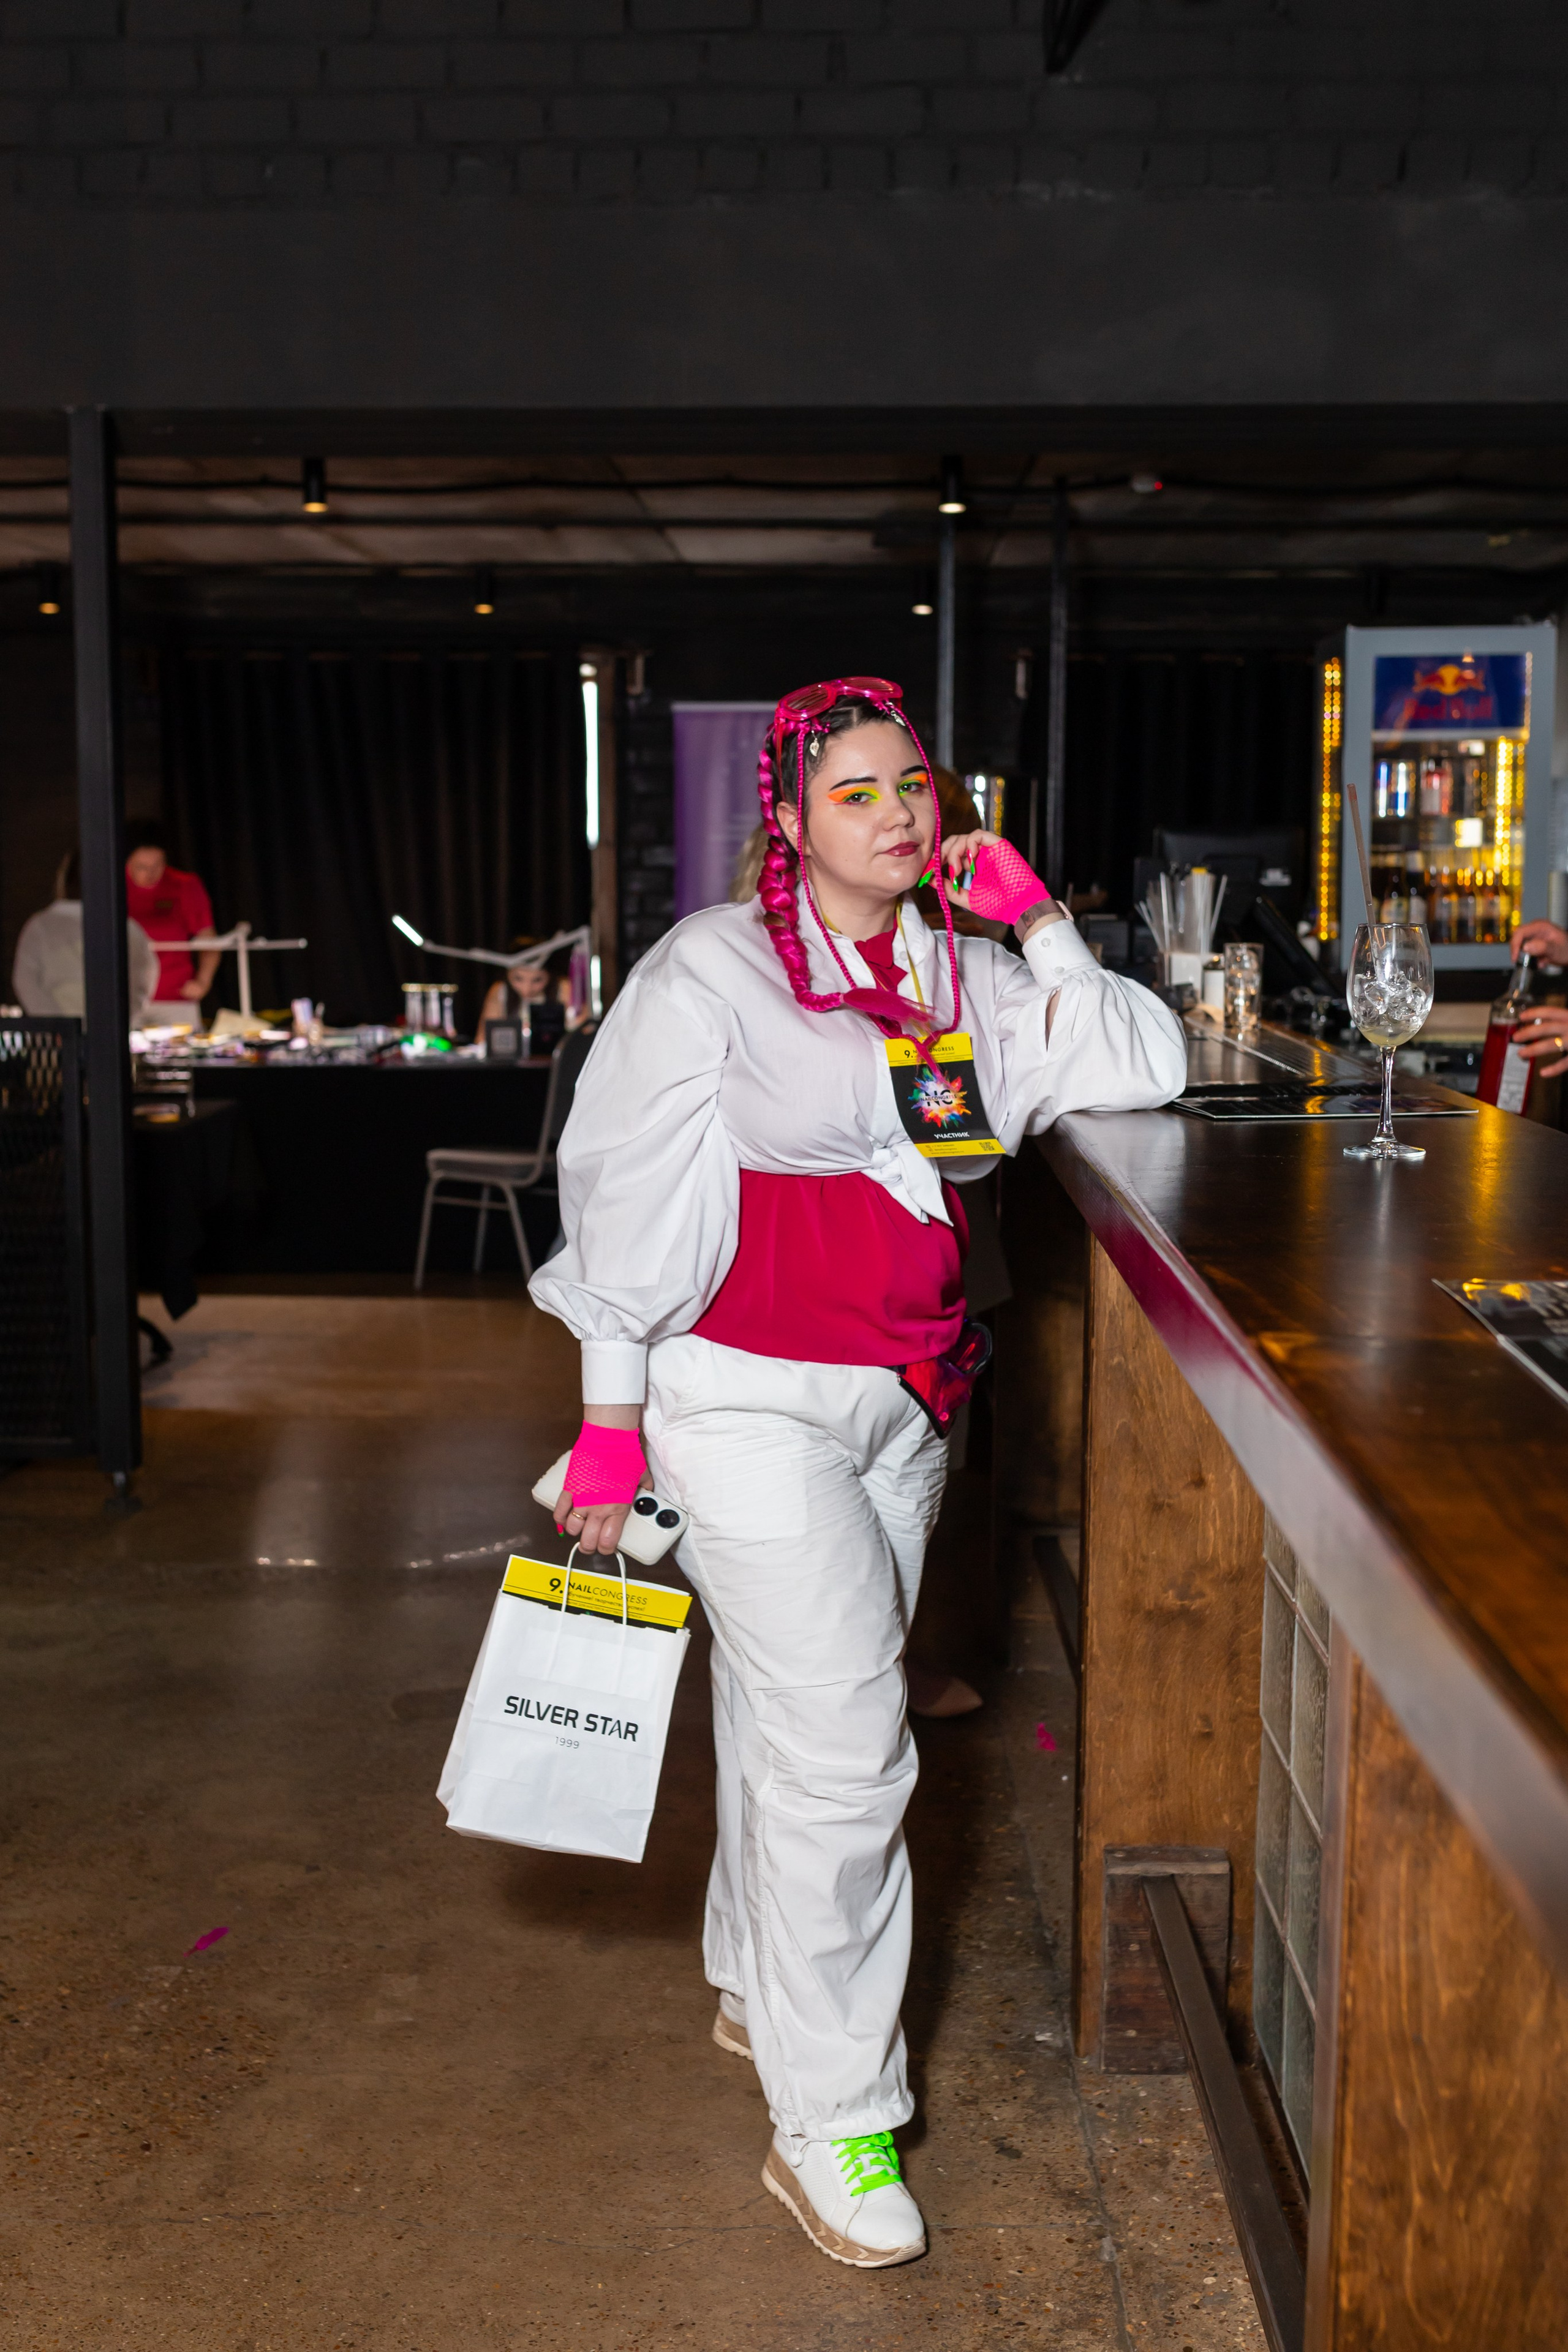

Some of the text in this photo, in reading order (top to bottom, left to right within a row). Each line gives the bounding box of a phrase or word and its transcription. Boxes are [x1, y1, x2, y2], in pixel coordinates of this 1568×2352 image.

[904, 1050, 913, 1058] 9.
[549, 1578, 647, 1605] 9. NAILCONGRESS
[504, 1695, 639, 1742] SILVER STAR
[555, 1736, 579, 1749] 1999
